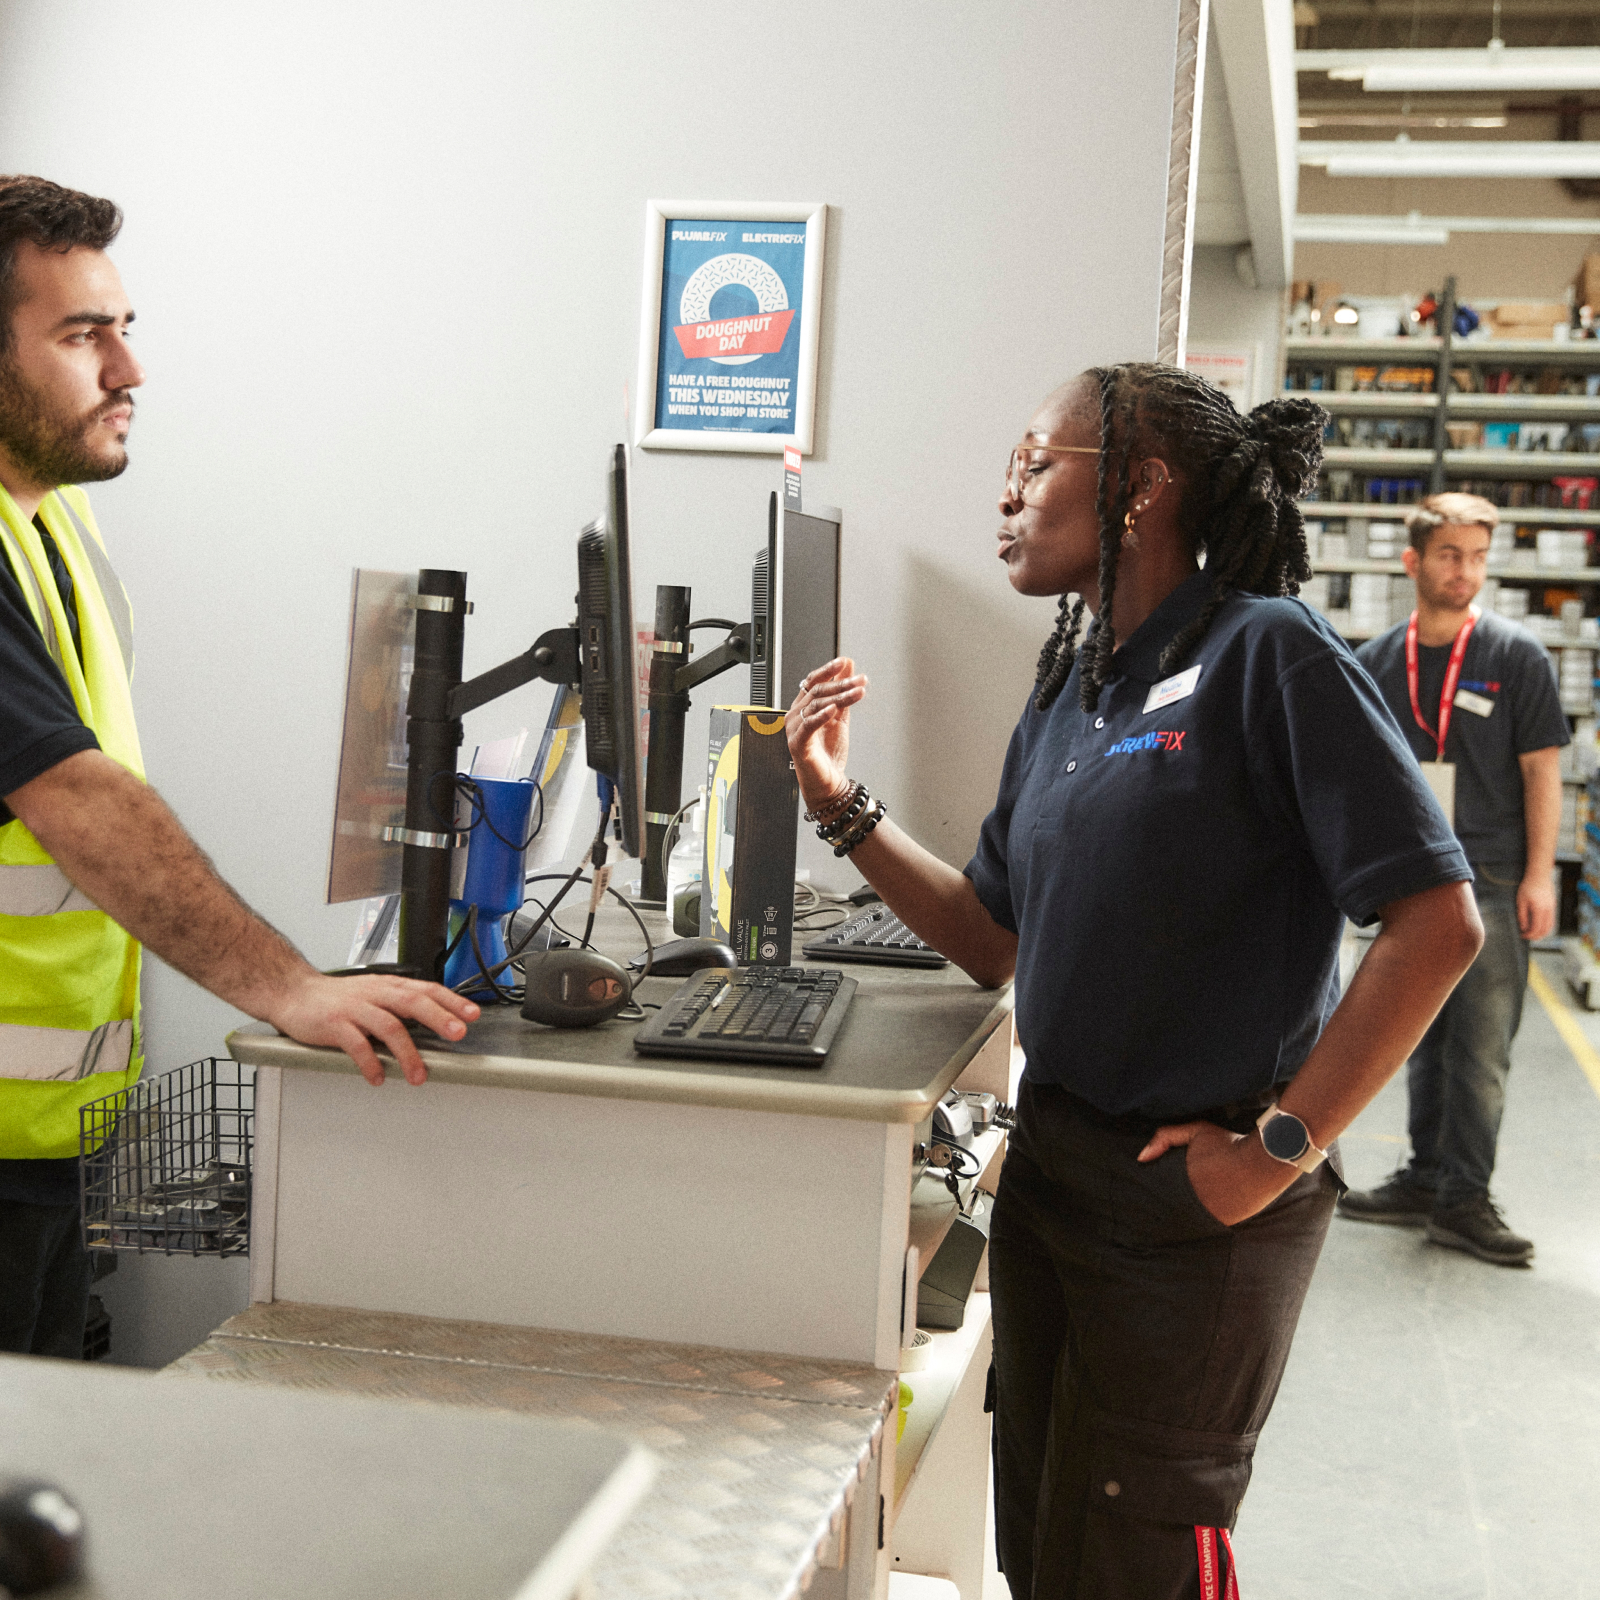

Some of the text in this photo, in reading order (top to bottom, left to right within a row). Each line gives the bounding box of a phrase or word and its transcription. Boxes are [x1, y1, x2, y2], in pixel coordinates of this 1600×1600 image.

[672, 230, 728, 242] PLUMBFIX
[742, 232, 805, 244] ELECTRICFIX
[695, 316, 772, 339] DOUGHNUT
[719, 334, 747, 351] DAY
[668, 374, 791, 389] HAVE A FREE DOUGHNUT
[668, 387, 790, 406] THIS WEDNESDAY
[668, 404, 698, 416] WHEN
[699, 405, 719, 416] YOU
[720, 406, 746, 417] SHOP
[746, 407, 758, 418] IN
[1202, 1528, 1214, 1600] ICE CHAMPION
